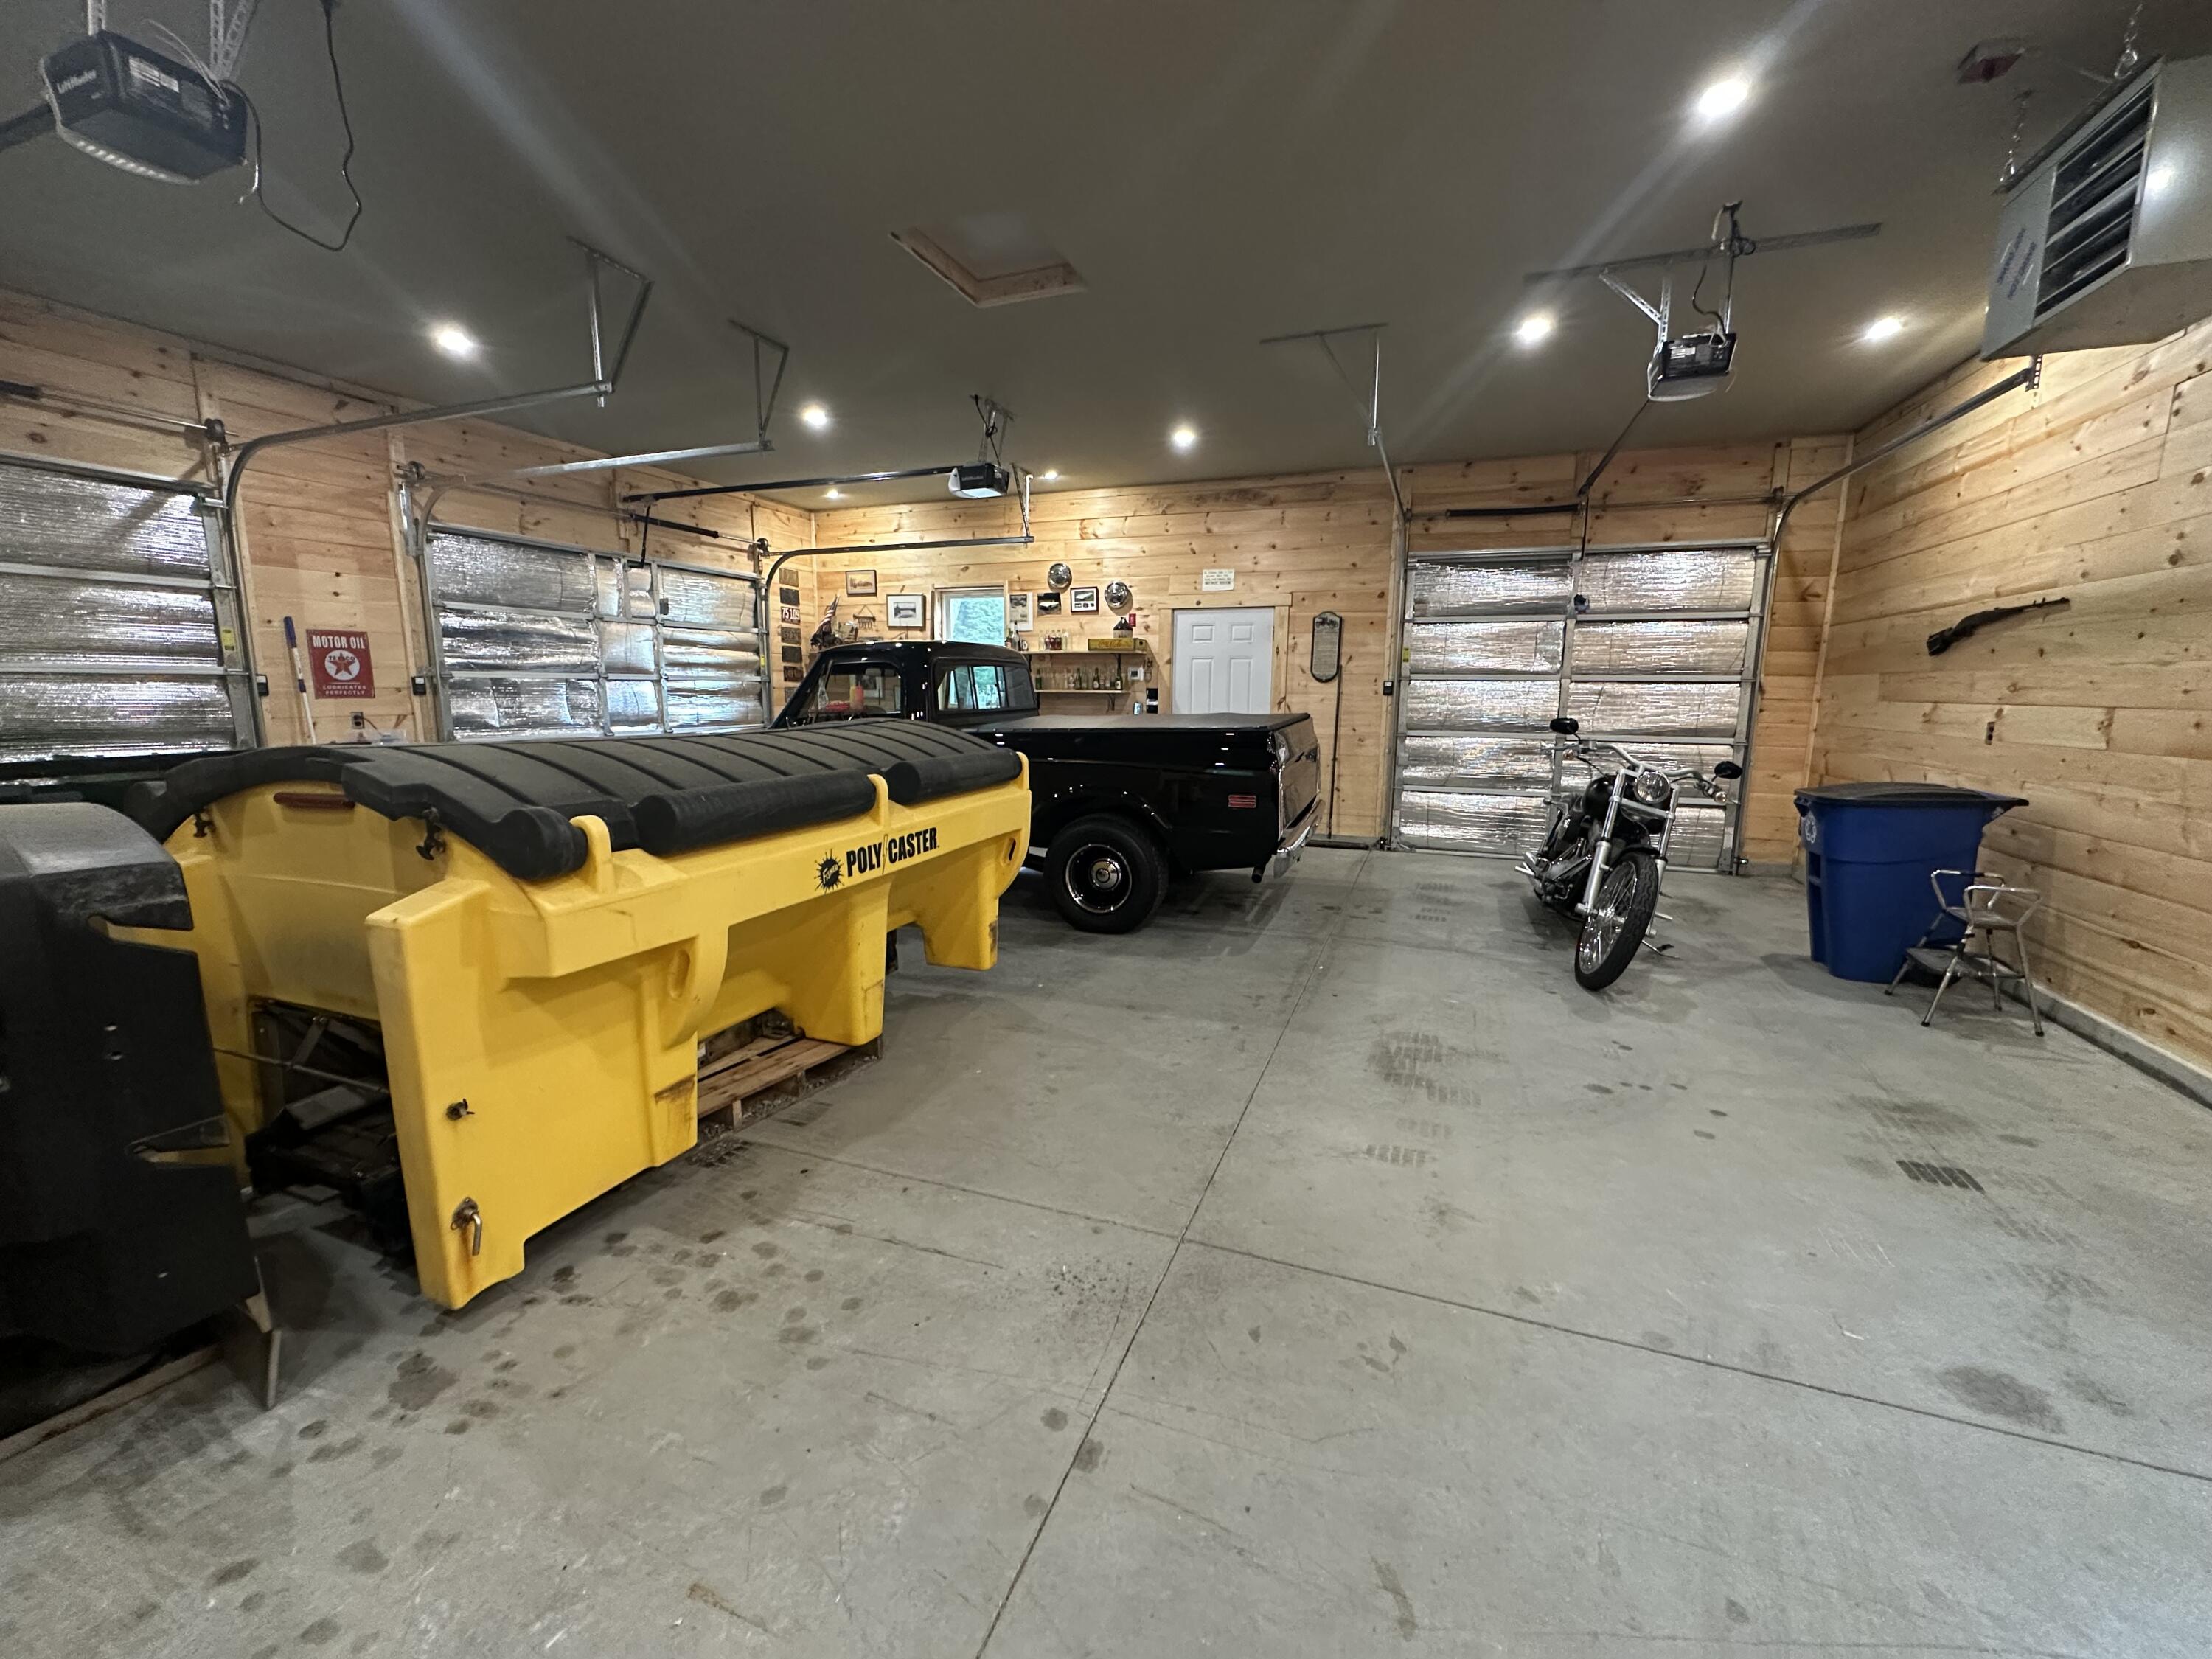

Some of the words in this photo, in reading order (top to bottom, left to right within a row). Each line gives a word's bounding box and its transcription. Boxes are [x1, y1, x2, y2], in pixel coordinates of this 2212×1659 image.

[312, 635, 348, 649] MOTOR
[349, 637, 366, 650] OIL
[846, 842, 882, 877] POLY
[887, 827, 937, 864] CASTER
